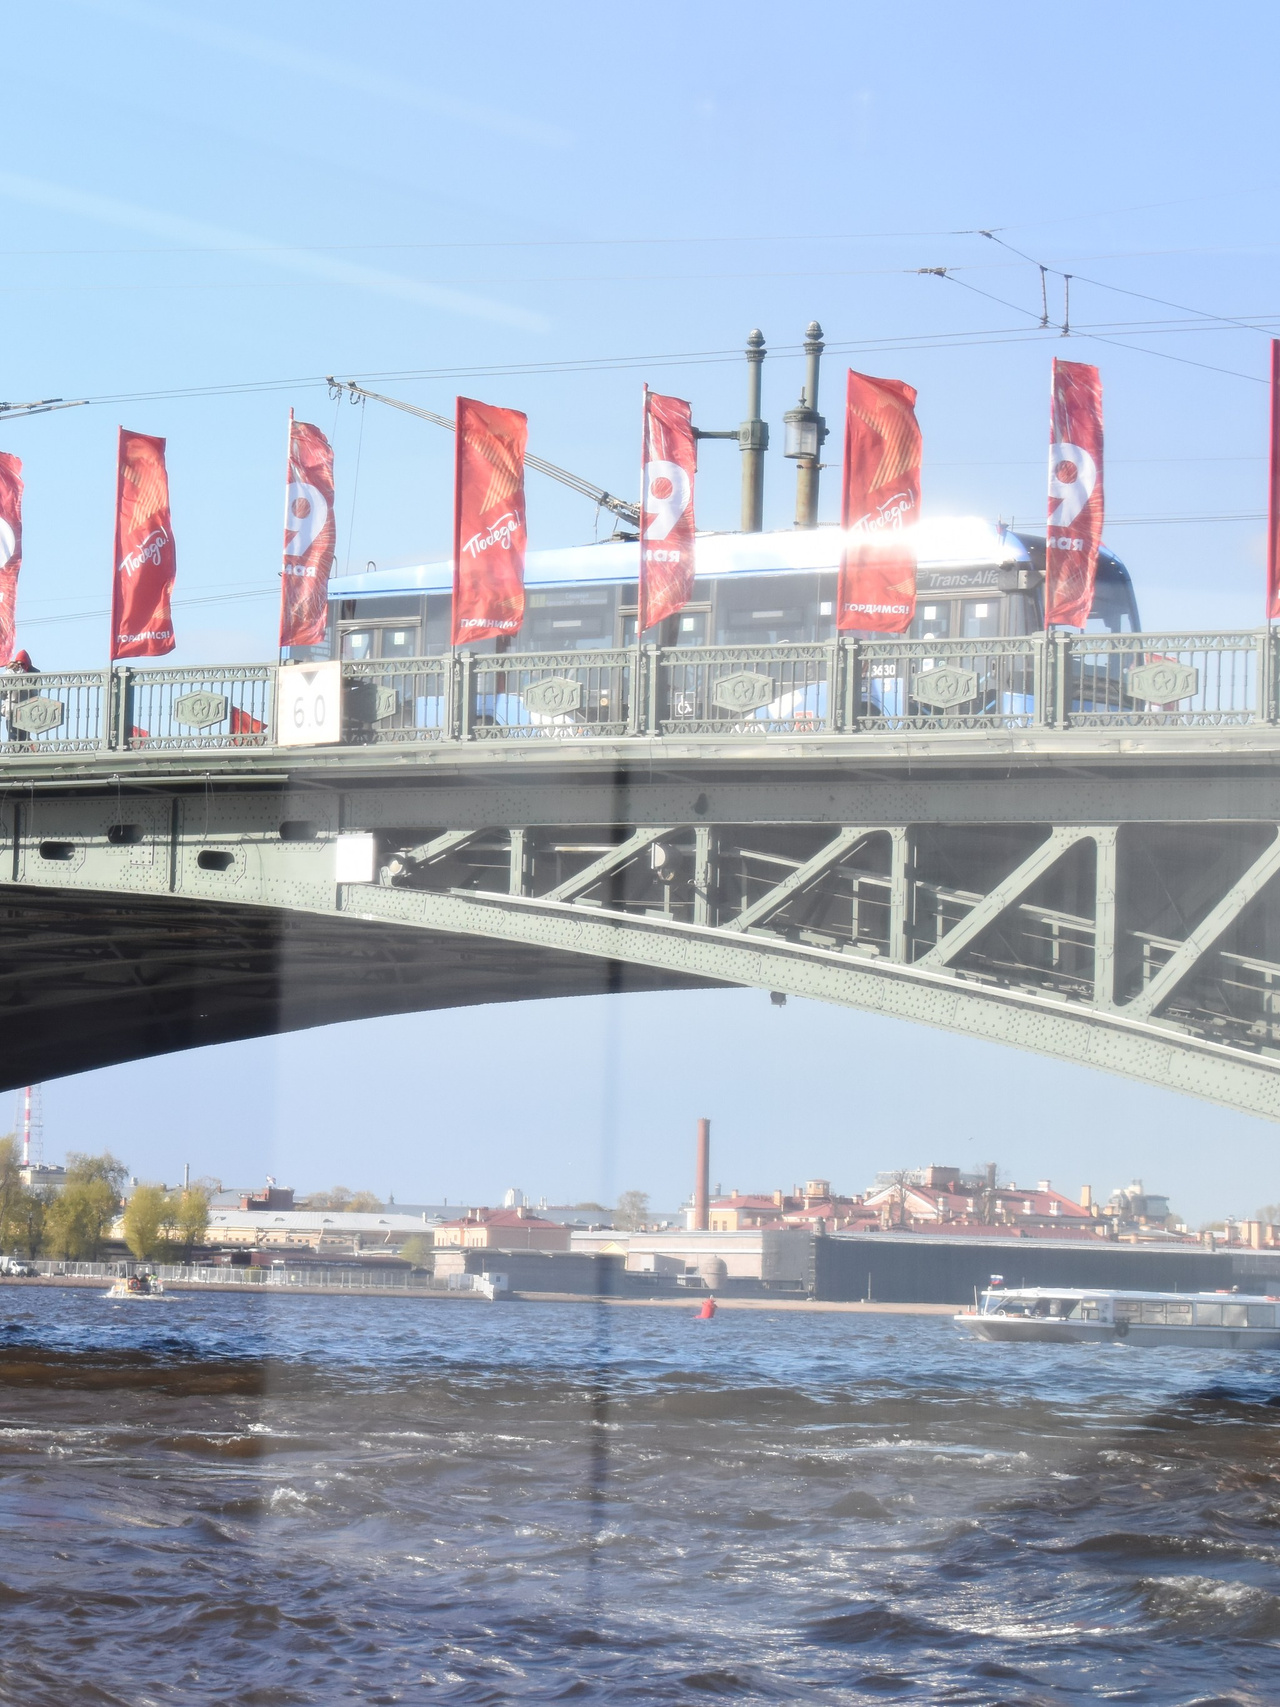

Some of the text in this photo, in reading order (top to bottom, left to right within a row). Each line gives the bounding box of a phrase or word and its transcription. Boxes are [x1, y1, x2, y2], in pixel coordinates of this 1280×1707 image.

[284, 482, 327, 556] 9
[642, 460, 690, 540] 9
[1047, 443, 1096, 527] 9
[872, 664, 896, 676] 3630
